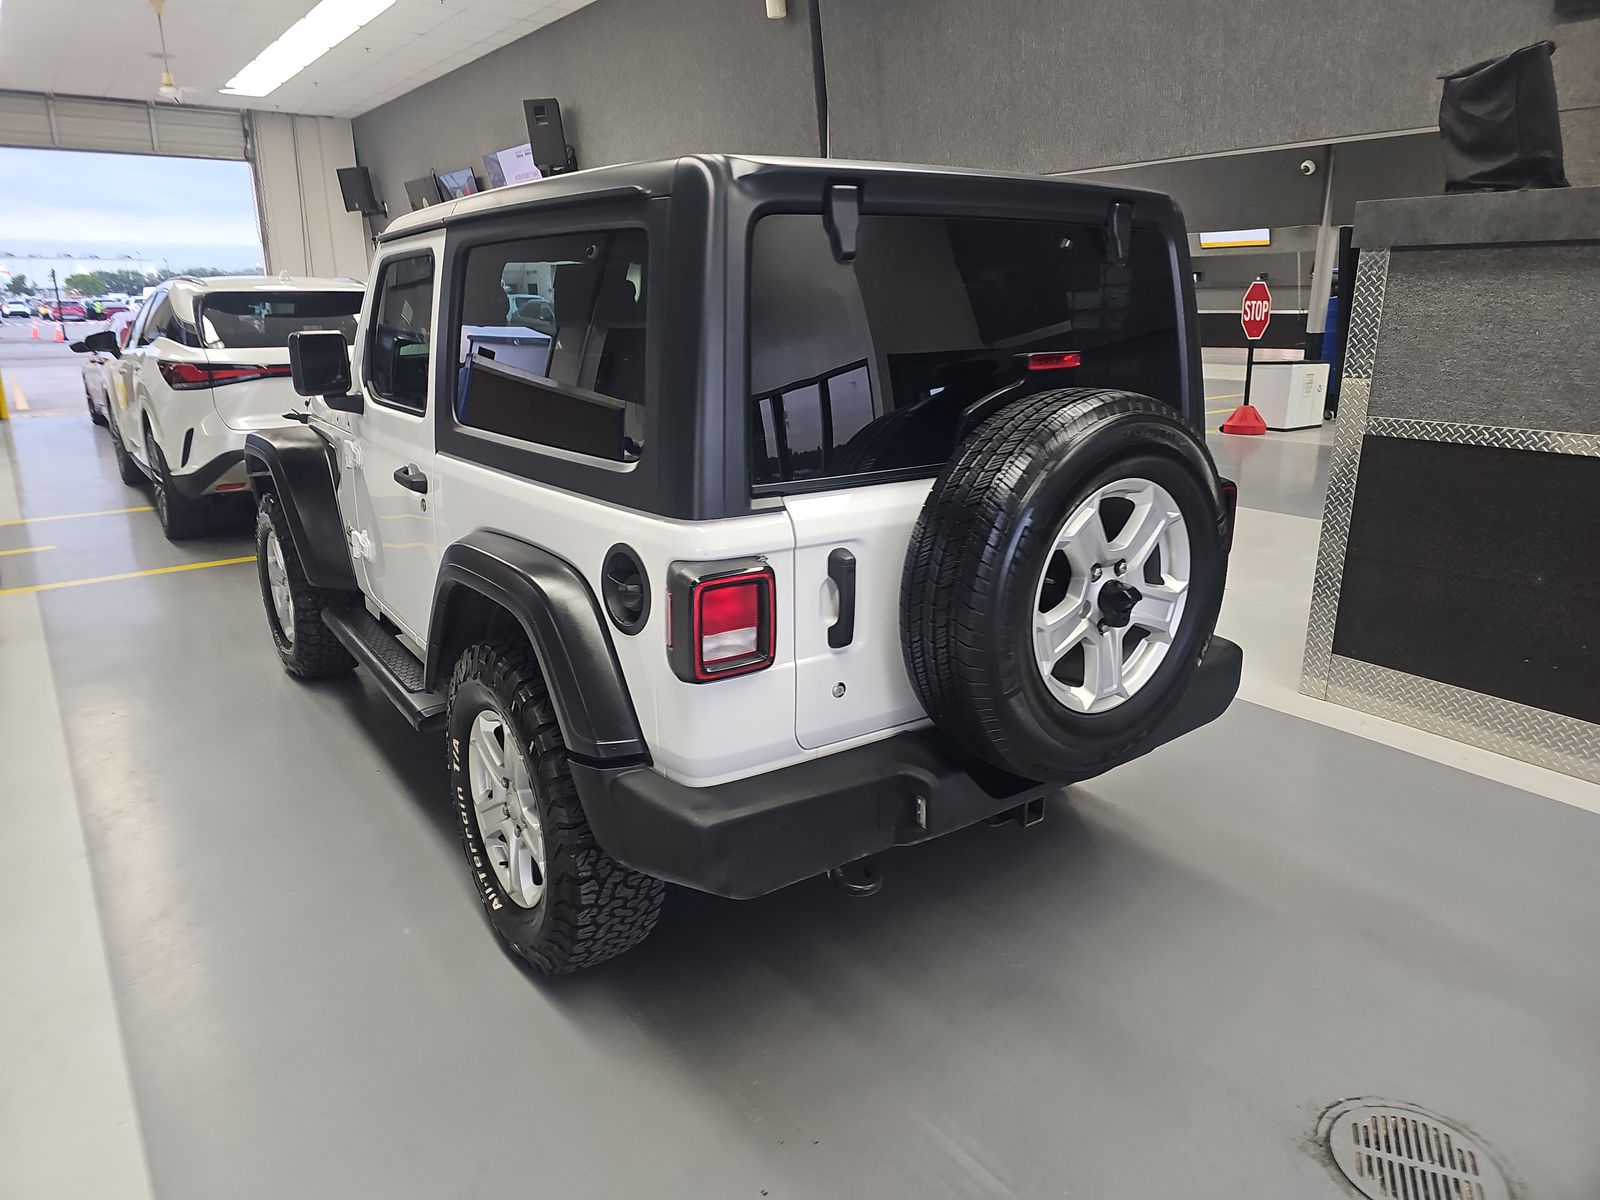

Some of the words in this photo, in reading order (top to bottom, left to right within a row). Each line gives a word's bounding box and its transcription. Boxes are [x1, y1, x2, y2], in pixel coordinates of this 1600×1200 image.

[1244, 300, 1269, 321] STOP
[452, 738, 460, 772] T/A
[457, 786, 503, 910] All-Terrain
